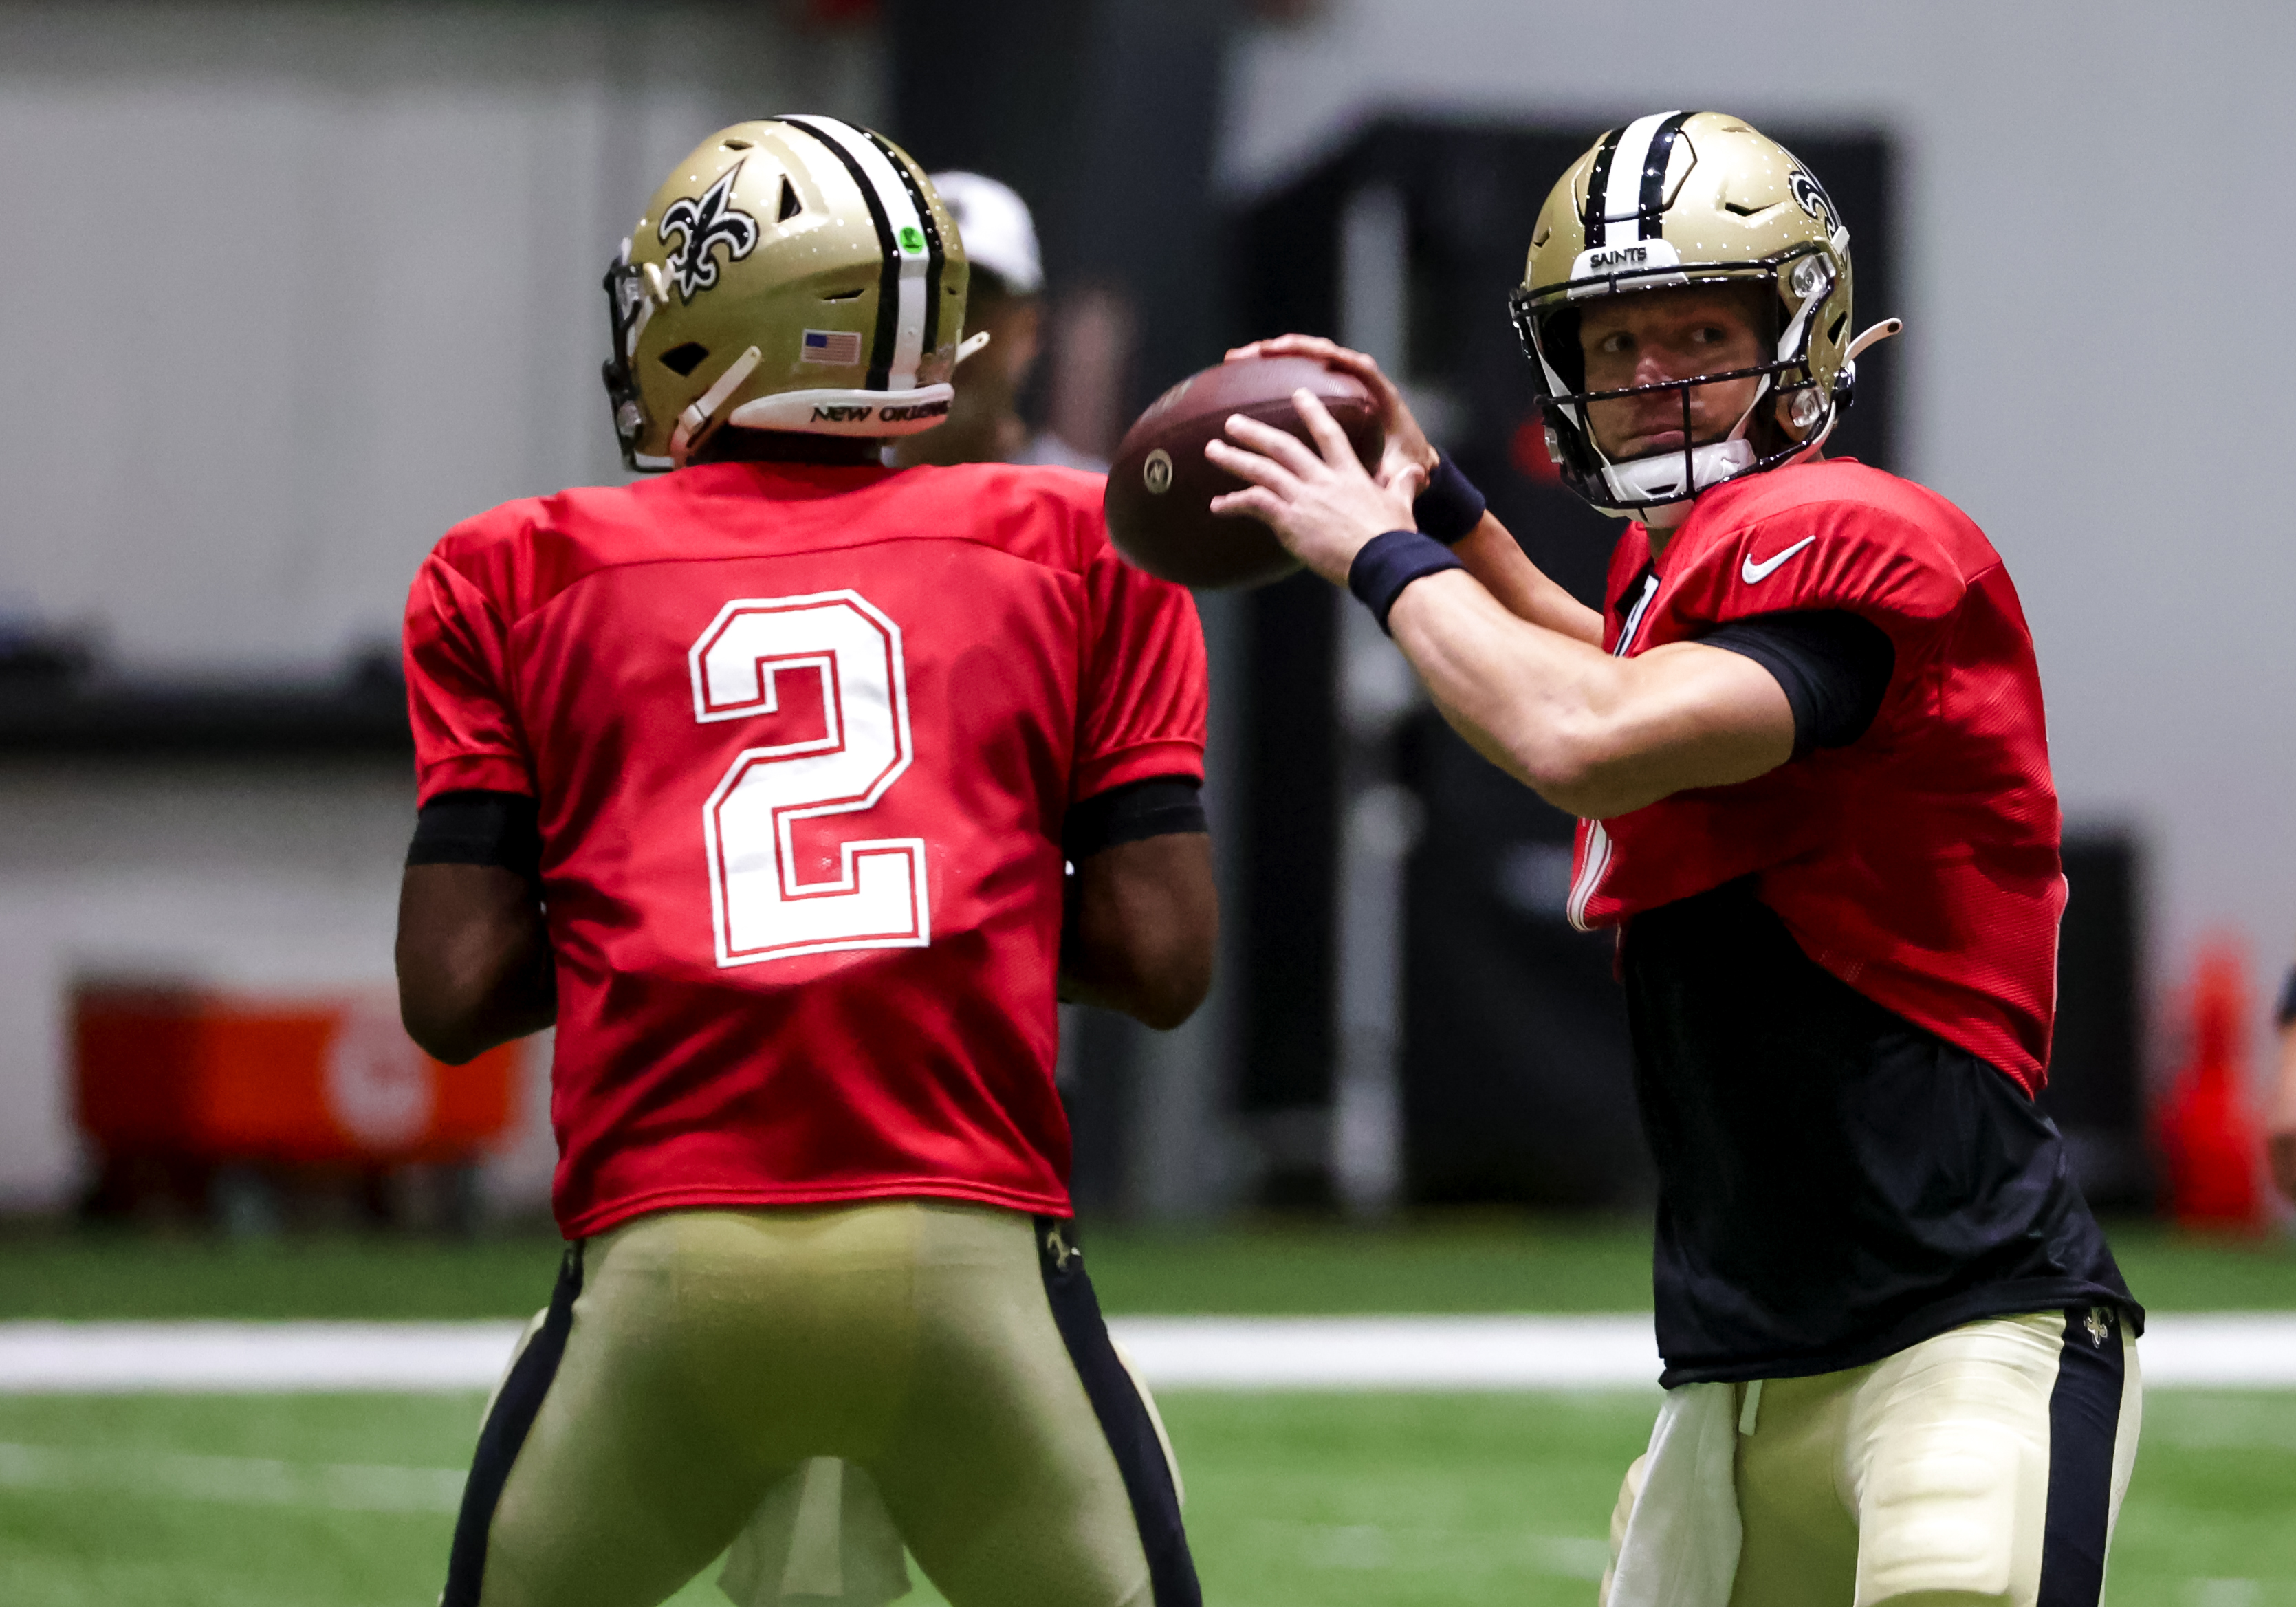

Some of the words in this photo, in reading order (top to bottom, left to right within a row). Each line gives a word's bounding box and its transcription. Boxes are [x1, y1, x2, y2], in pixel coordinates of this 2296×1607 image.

[1590, 247, 1647, 269] SAINTS
[810, 405, 873, 422] NEW
[688, 588, 931, 968] 2
